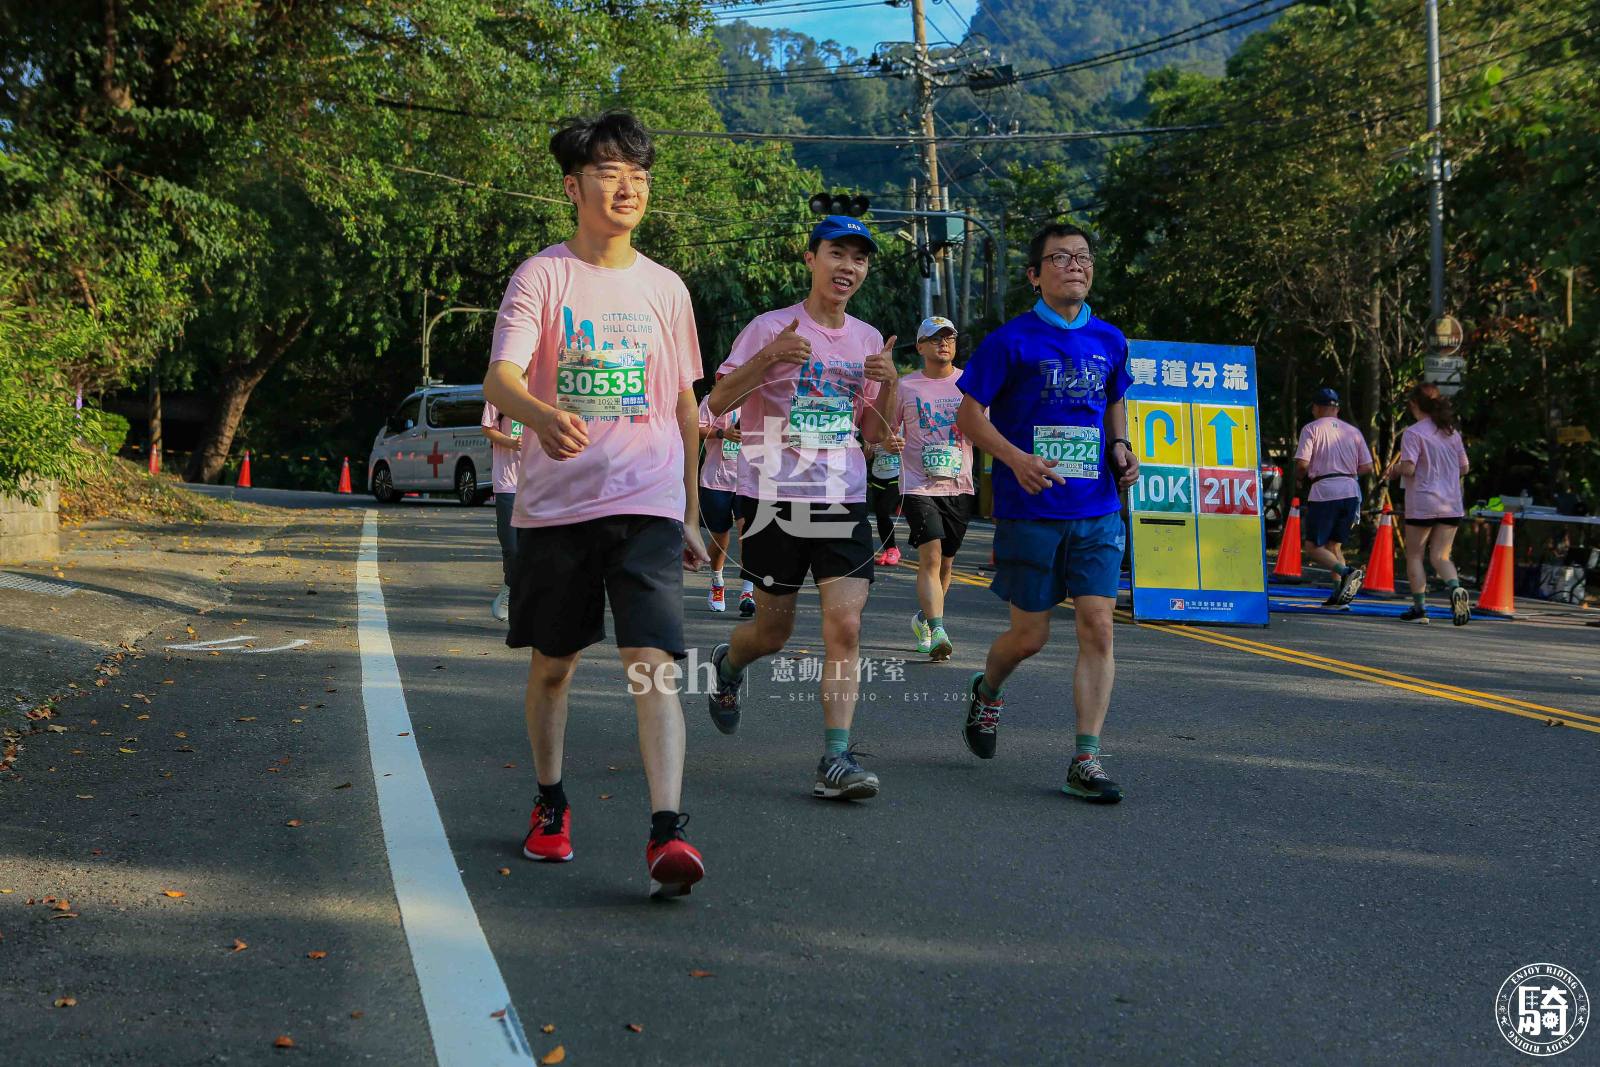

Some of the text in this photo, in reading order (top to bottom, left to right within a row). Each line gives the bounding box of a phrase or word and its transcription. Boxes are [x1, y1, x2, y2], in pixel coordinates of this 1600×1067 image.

[601, 312, 652, 322] CITTASLOW
[603, 324, 653, 334] HILL CLIMB
[560, 370, 642, 394] 30535
[1130, 357, 1249, 391] 賽道分流
[792, 413, 851, 433] 30524
[1036, 443, 1097, 461] 30224
[1136, 474, 1189, 506] 10K
[1204, 477, 1254, 507] 21K
